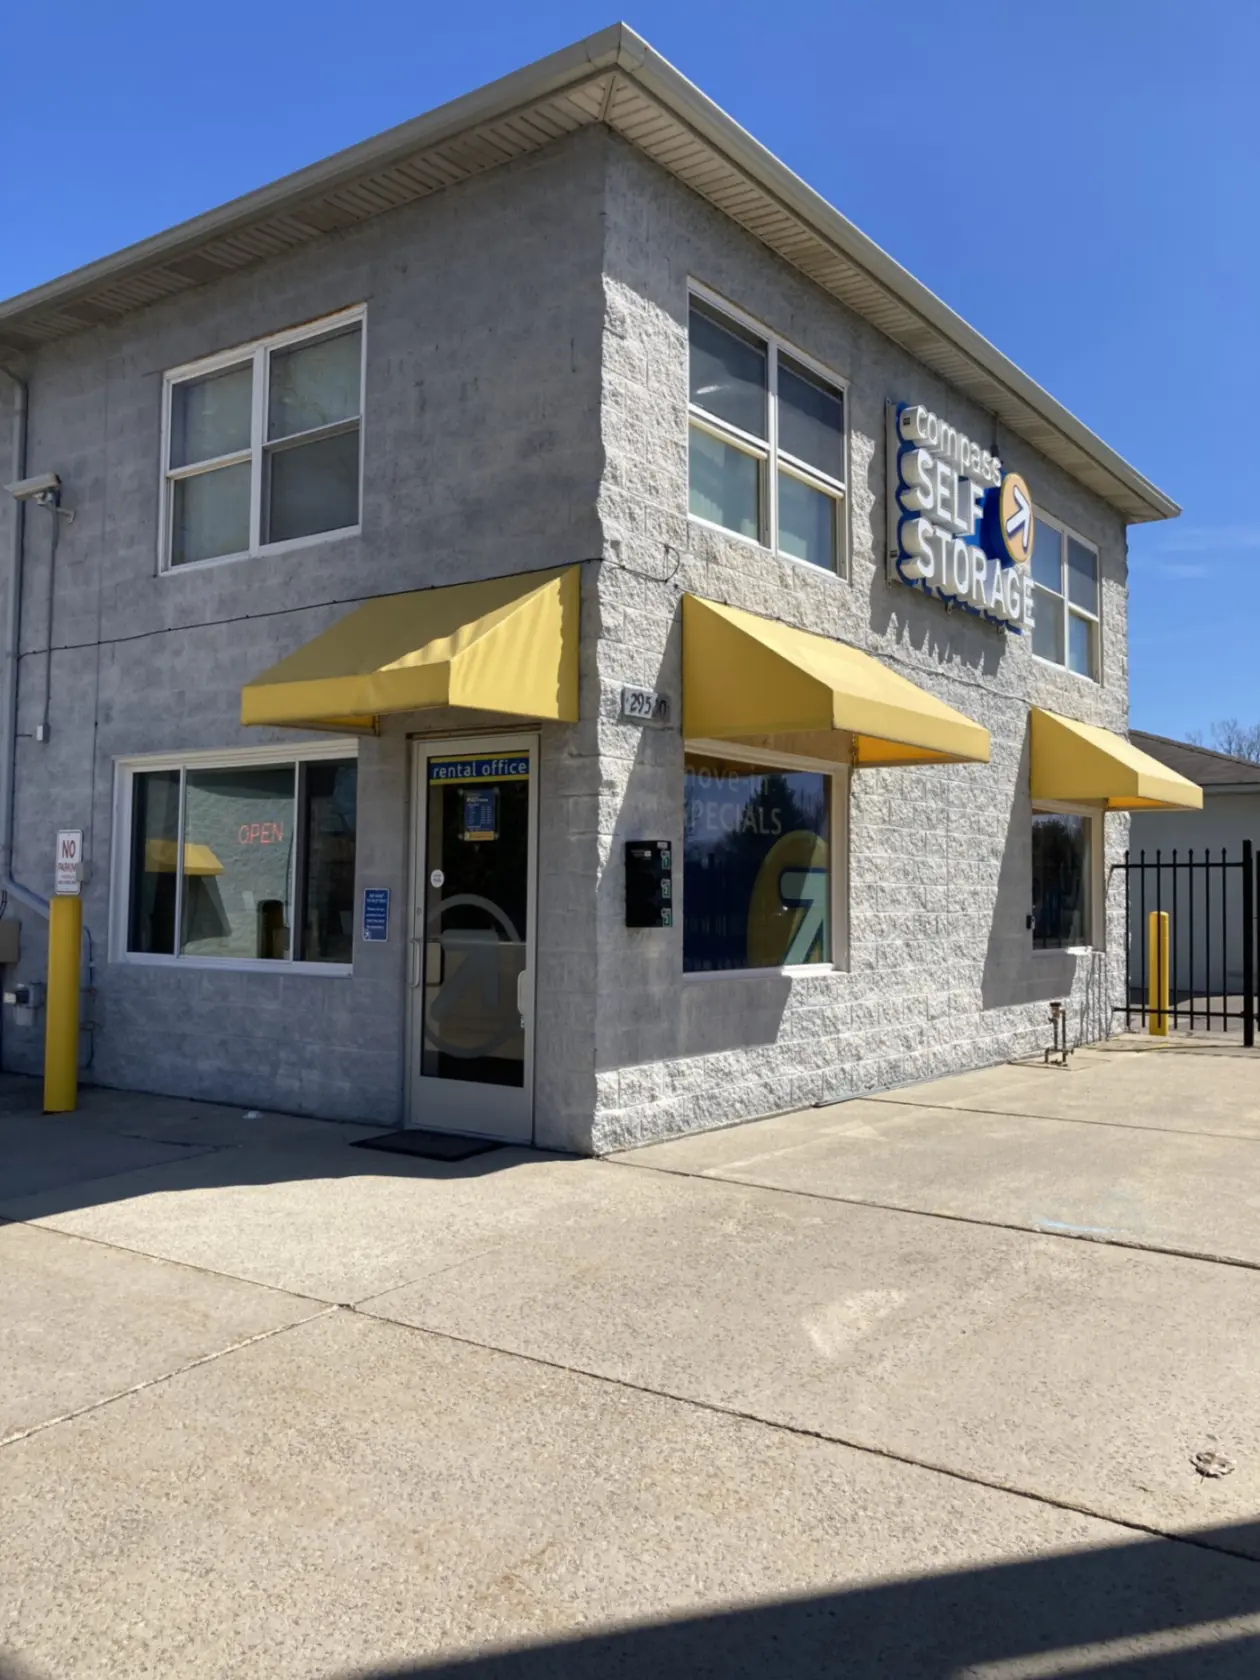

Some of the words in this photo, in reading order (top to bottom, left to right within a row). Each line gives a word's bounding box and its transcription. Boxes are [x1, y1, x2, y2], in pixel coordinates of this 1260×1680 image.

[914, 448, 984, 537] SELF
[915, 517, 1036, 629] STORAGE
[432, 760, 477, 779] rental
[481, 758, 528, 776] office
[238, 820, 284, 845] OPEN
[684, 800, 782, 836] PECIALS
[62, 839, 76, 859] NO
